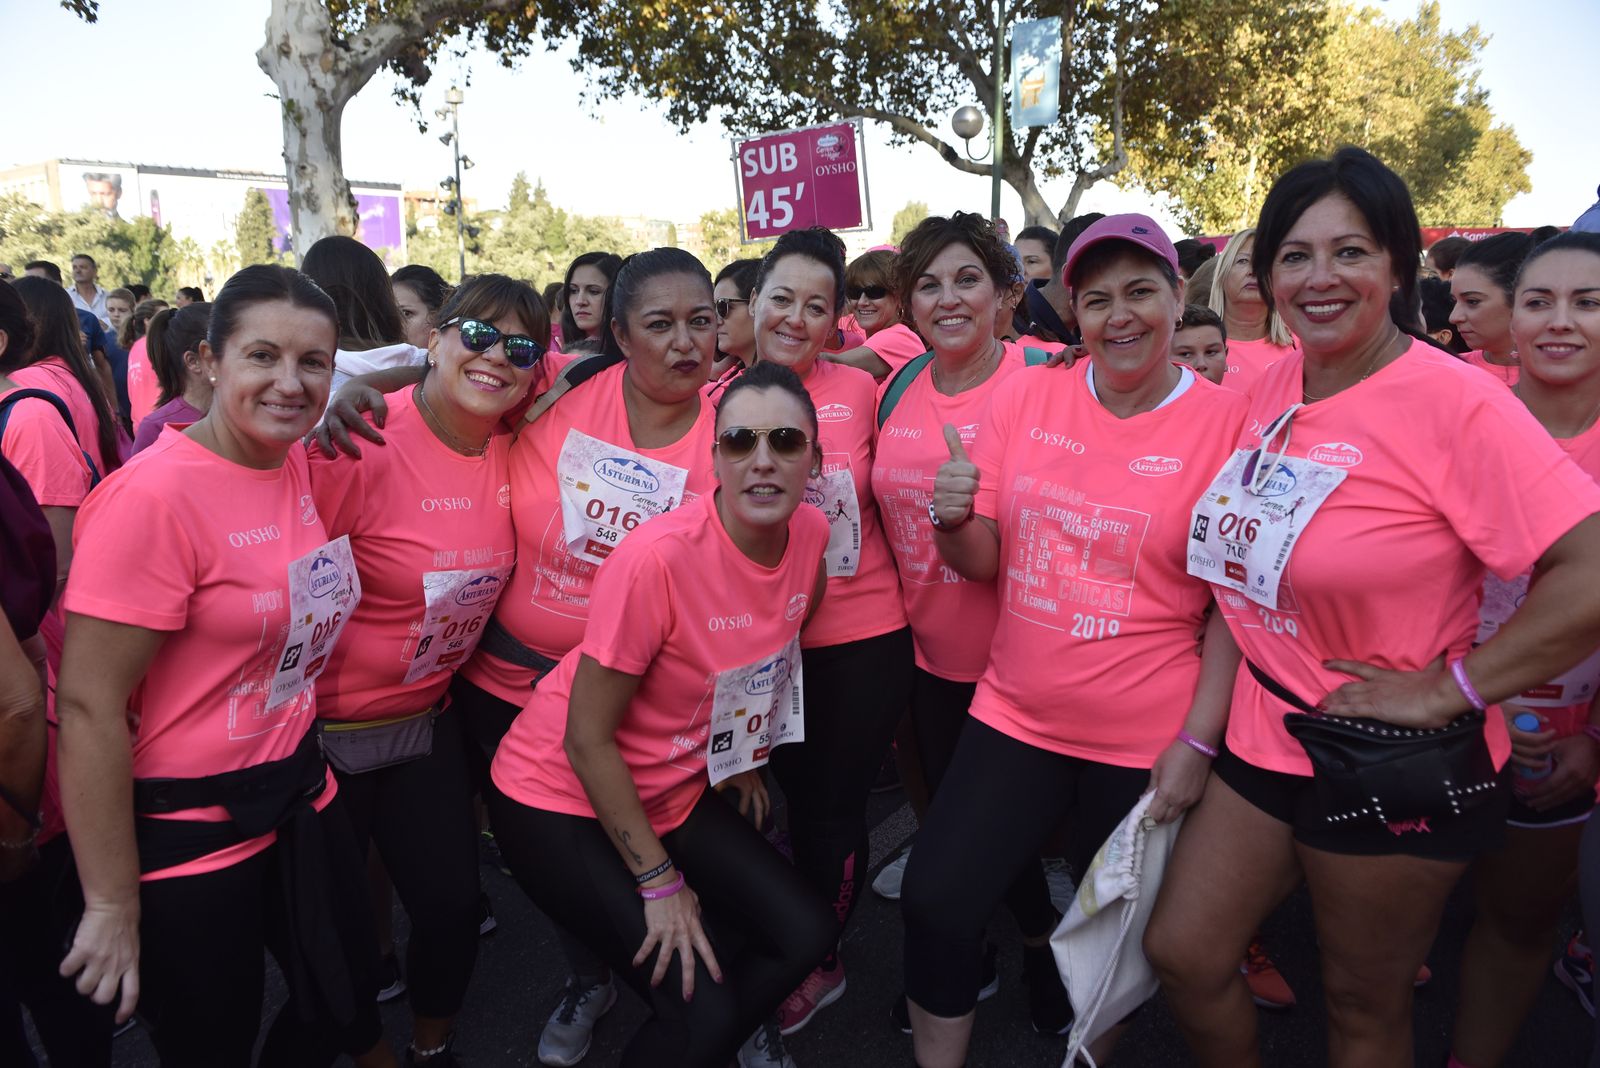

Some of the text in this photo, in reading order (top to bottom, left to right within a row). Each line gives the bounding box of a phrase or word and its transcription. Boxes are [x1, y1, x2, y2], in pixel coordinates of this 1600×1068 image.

[743, 142, 798, 178] SUB
[815, 161, 856, 177] OYSHO
[747, 181, 805, 229] 45'
[1030, 427, 1085, 455] OYSHO
[1133, 461, 1178, 472] ASTURIANA
[1310, 451, 1357, 464] ASTURIANA
[597, 463, 653, 491] ASTURIANA
[824, 463, 841, 473] TEIZ
[632, 494, 658, 507] Carrera
[899, 489, 927, 498] VITORIA
[1039, 481, 1086, 505] GANAN
[422, 497, 471, 512] OYSHO
[915, 499, 932, 509] MAD
[585, 499, 642, 531] 016
[1045, 506, 1082, 525] VITORIA
[1090, 517, 1129, 535] GASTEIZ
[228, 524, 280, 548] OYSHO
[595, 527, 618, 542] 548
[1062, 521, 1100, 541] MADRID
[1218, 513, 1262, 544] 016
[1040, 537, 1048, 549] VA
[433, 551, 458, 568] HOY
[1038, 549, 1052, 561] LEN
[939, 565, 960, 583] 20
[1036, 559, 1048, 571] CIA
[1055, 560, 1077, 577] LAS
[458, 586, 499, 602] ASTURIANA
[1058, 578, 1125, 610] CHICAS
[311, 610, 342, 647] 016
[443, 616, 482, 640] 016
[708, 613, 753, 632] OYSHO
[1071, 613, 1120, 640] 2019
[447, 640, 463, 650] 549
[746, 699, 779, 735] 016
[758, 732, 771, 744] 55
[713, 756, 743, 774] OYSHO
